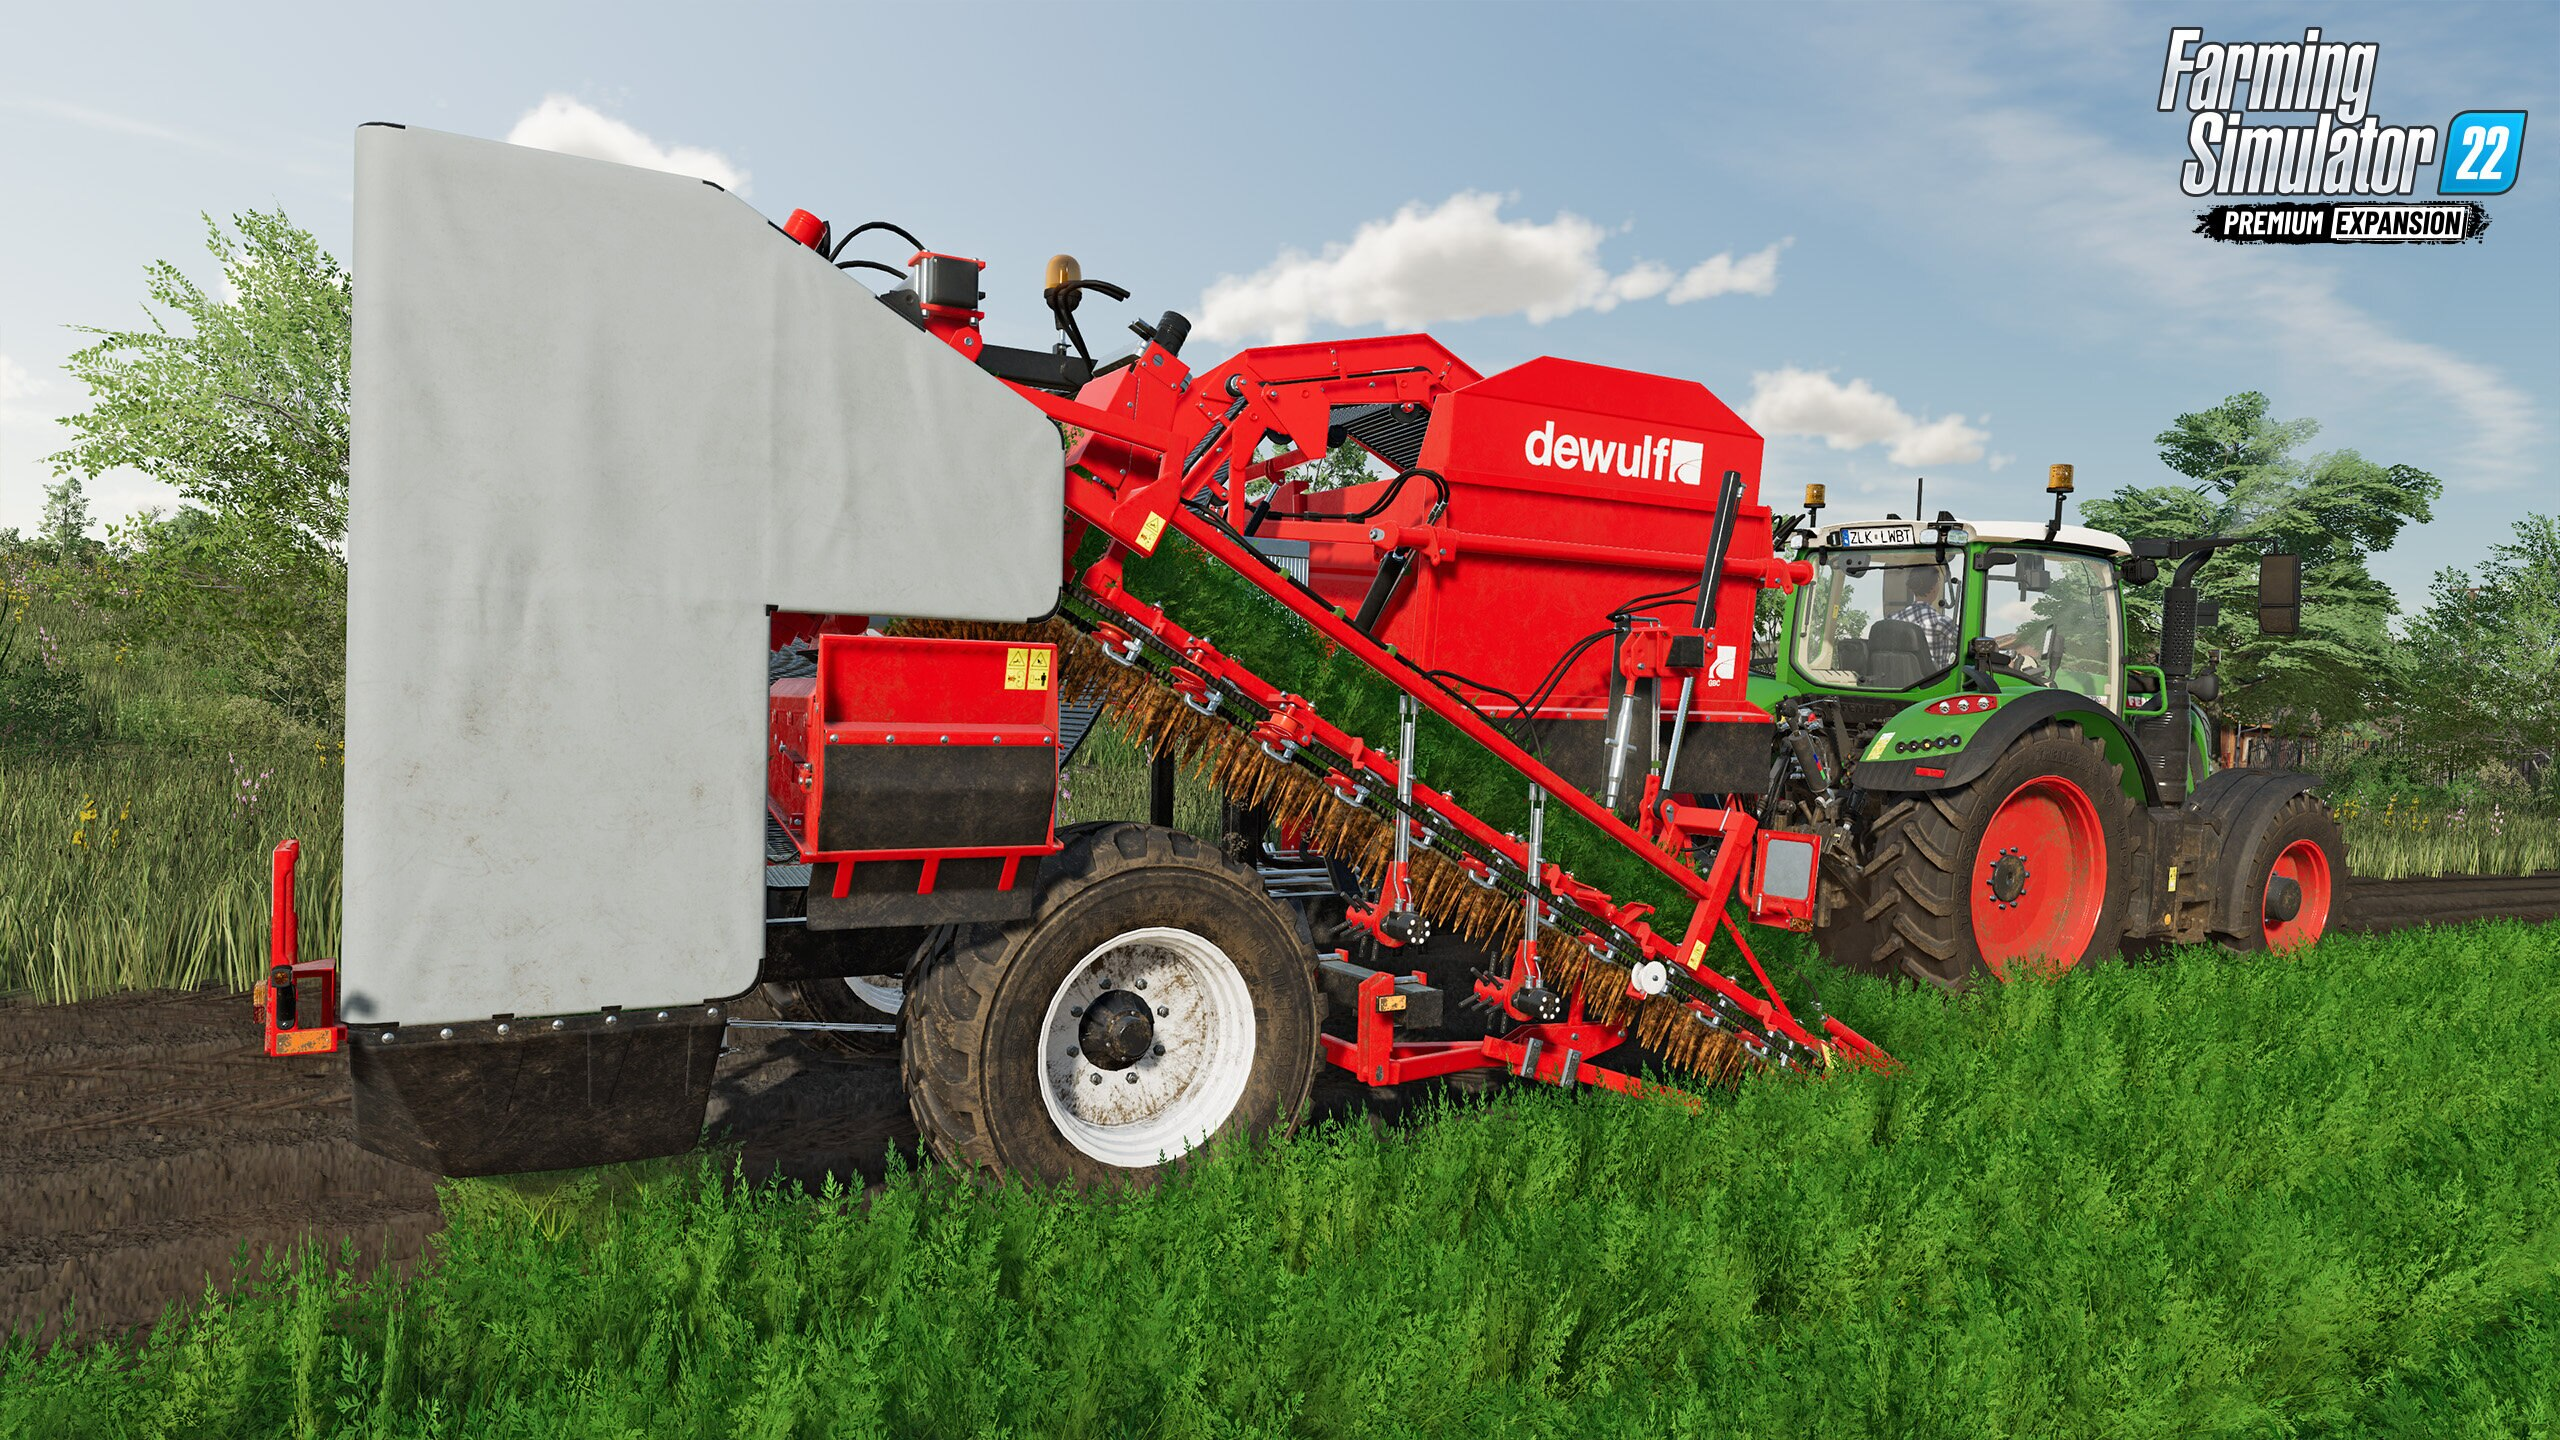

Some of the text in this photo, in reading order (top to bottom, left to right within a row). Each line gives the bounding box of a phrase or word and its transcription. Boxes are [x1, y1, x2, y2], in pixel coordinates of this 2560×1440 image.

[1525, 420, 1670, 481] dewulf
[1850, 529, 1910, 544] ZLK LWBT
